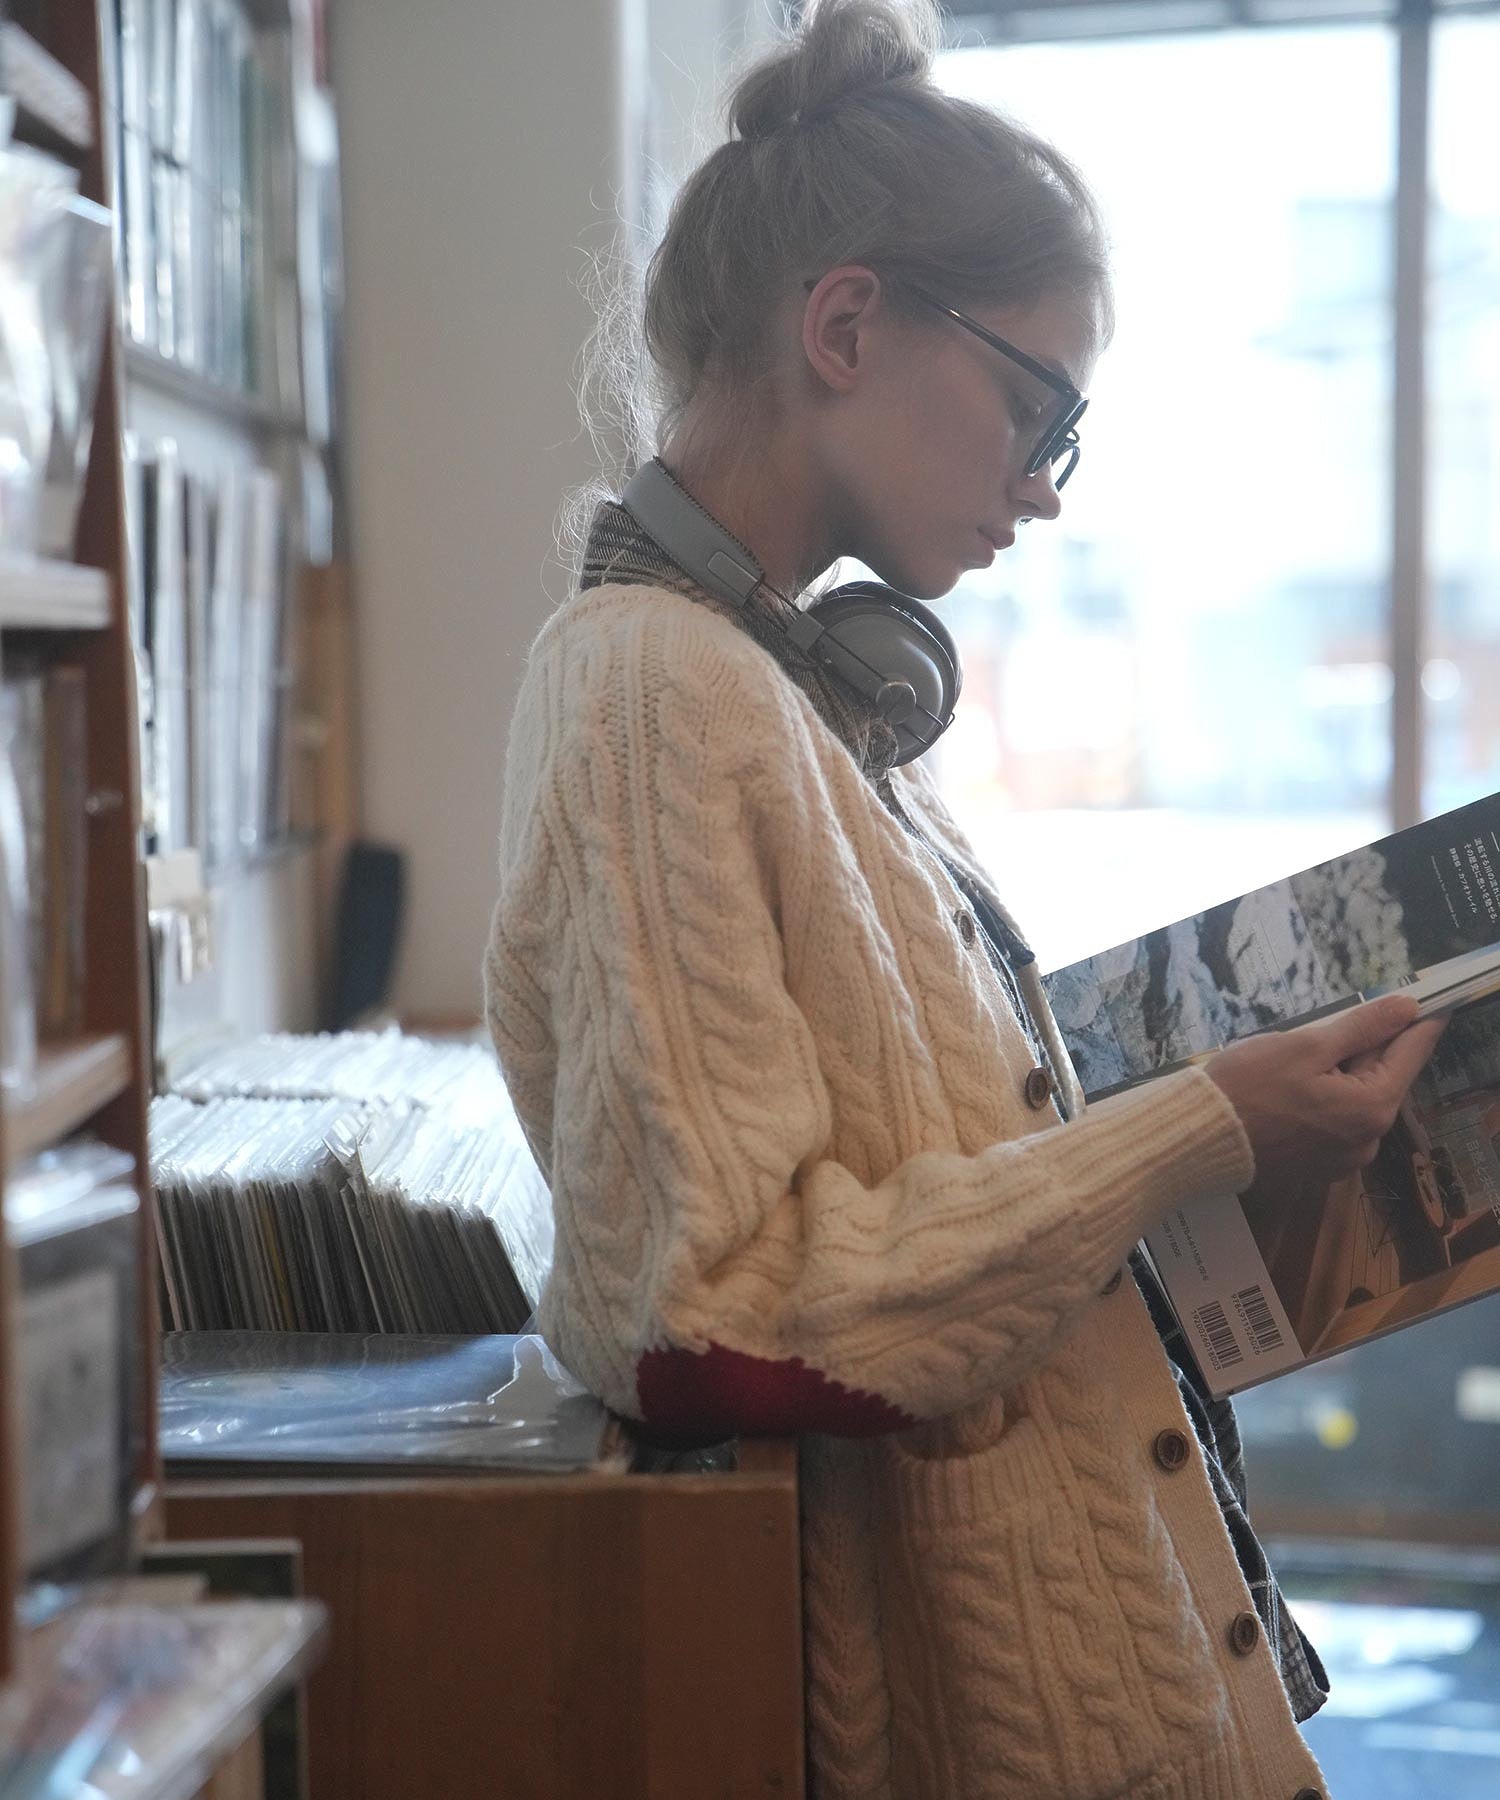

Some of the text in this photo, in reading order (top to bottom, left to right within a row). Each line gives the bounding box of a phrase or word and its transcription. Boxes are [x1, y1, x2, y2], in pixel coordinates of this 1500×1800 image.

[1474, 837, 1500, 908] 流転する川の流れに
[1191, 1308, 1221, 1371] 1920026018003
[1231, 1293, 1261, 1355] 9784911526026
